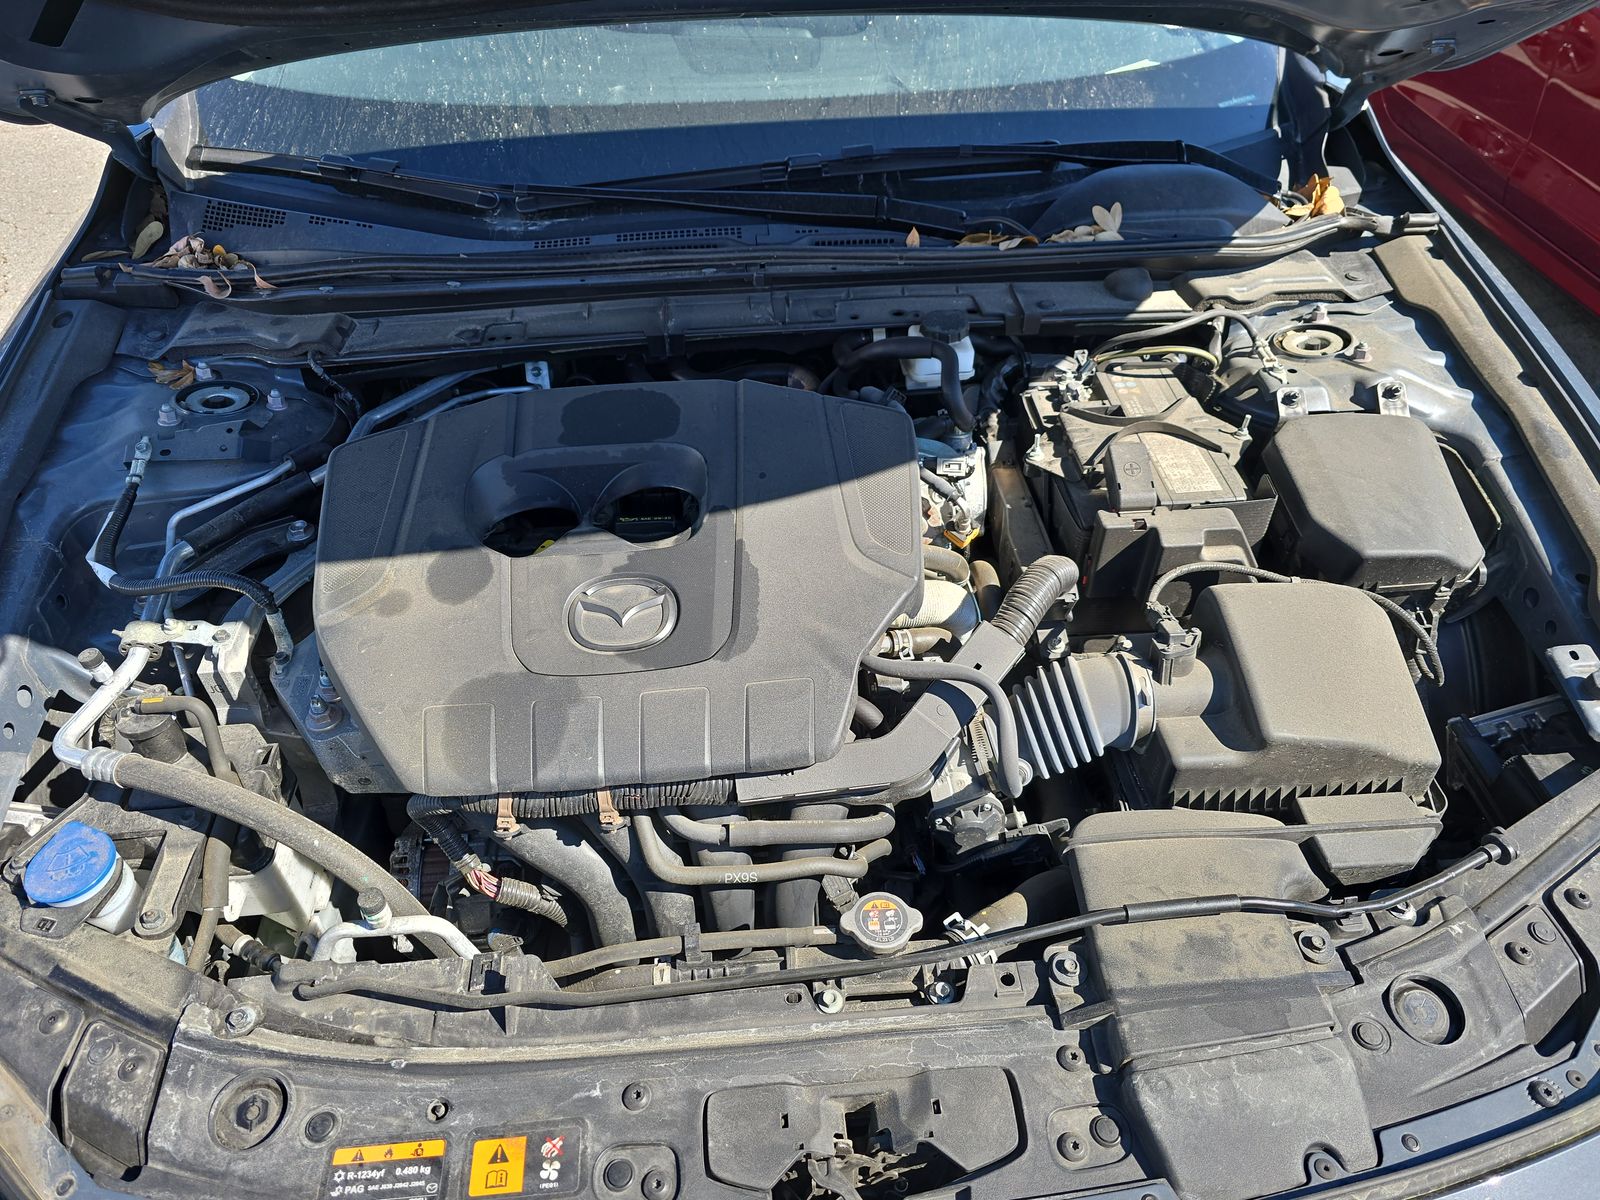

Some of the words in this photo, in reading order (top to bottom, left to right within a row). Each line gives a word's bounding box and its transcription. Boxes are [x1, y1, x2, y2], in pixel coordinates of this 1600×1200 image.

[724, 872, 758, 884] PX9S
[346, 1169, 386, 1180] R-1234yf
[395, 1167, 418, 1176] 0.480
[419, 1165, 431, 1175] kg
[344, 1184, 365, 1195] PAG
